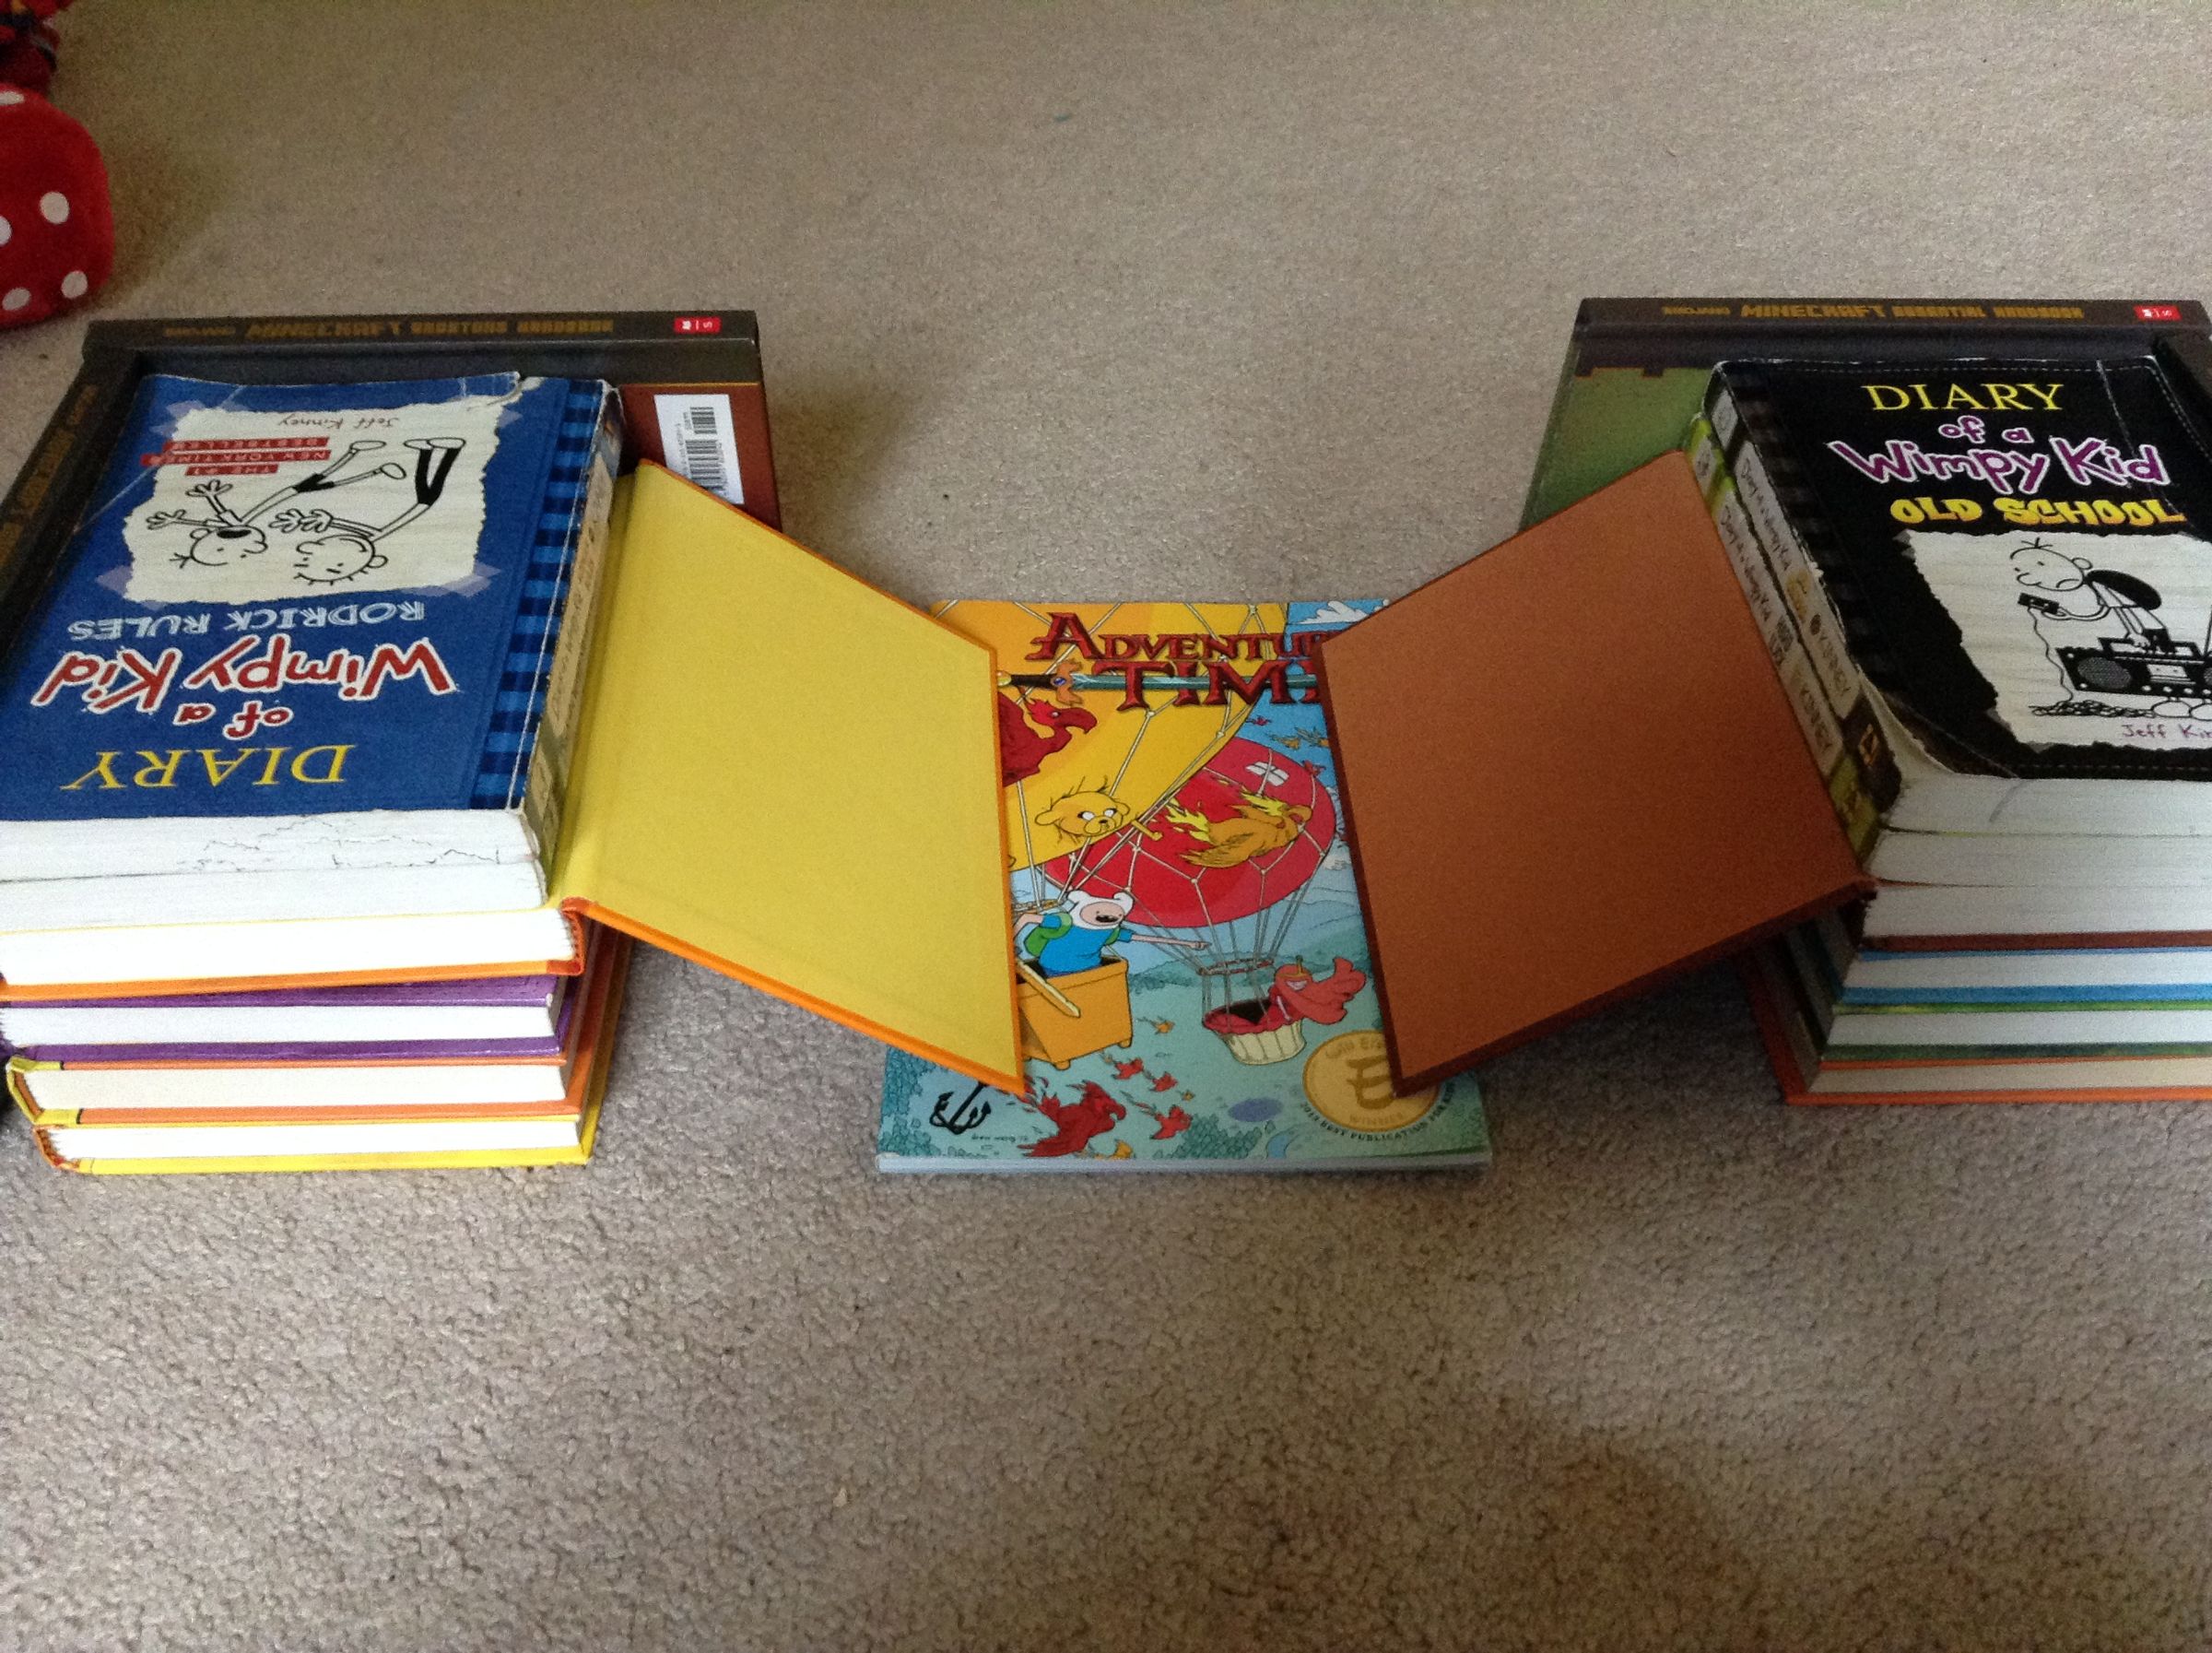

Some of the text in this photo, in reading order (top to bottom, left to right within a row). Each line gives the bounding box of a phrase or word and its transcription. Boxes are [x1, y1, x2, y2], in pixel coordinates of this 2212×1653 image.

[1739, 303, 1887, 318] MINECRAFT
[1861, 383, 2065, 411] DIARY
[278, 413, 399, 431] Jeff Kinney
[1937, 414, 2035, 444] of a
[1826, 434, 2172, 495] Wimpy Kid
[1889, 496, 2188, 526] OLD SCHOOL
[66, 600, 426, 643] RODRICK RULES
[29, 633, 460, 715] Wimpy Kid
[172, 699, 293, 740] of a
[2121, 723, 2167, 738] Jeff
[60, 742, 357, 791] DIARY
